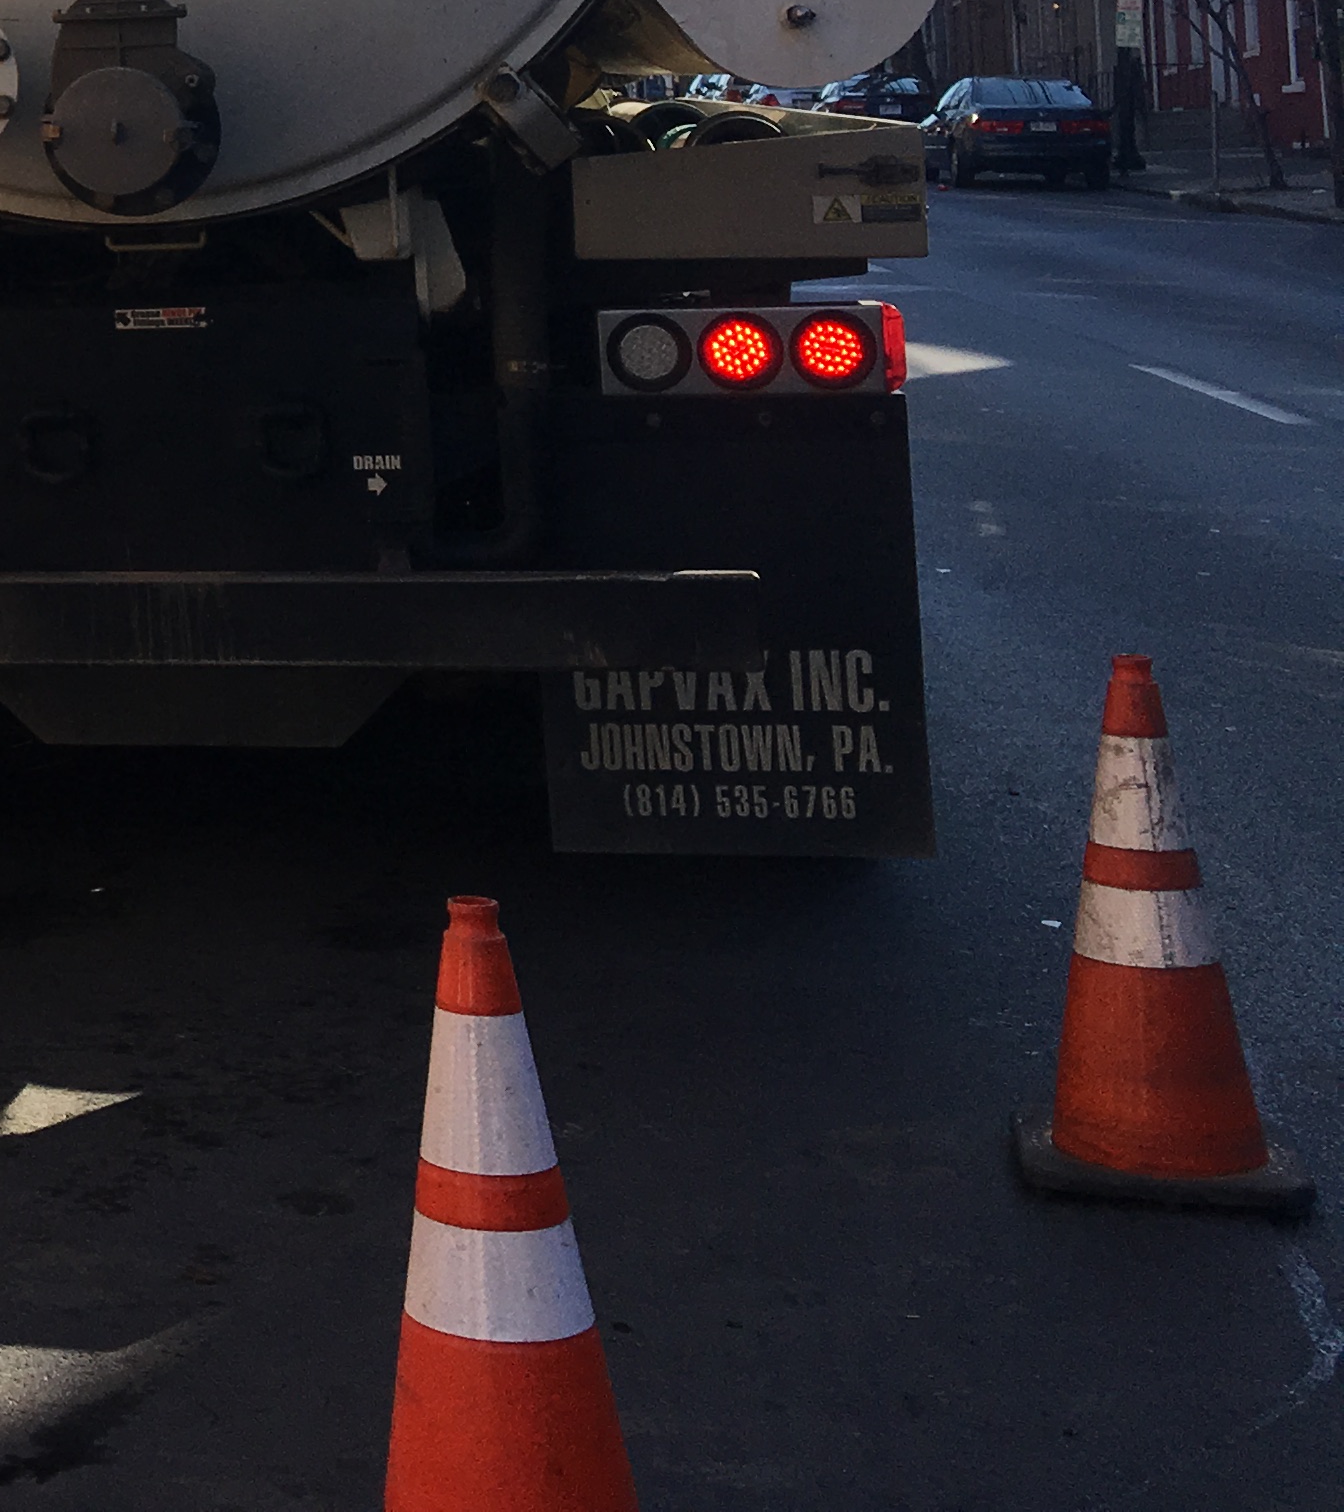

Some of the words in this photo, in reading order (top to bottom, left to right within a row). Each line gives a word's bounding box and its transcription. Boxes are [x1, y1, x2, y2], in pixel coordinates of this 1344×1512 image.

[352, 454, 402, 472] DRAIN
[573, 658, 772, 711] GAPVAX
[789, 648, 890, 713] INC.
[580, 722, 815, 772] JOHNSTOWN,
[831, 724, 894, 774] PA.
[622, 784, 701, 818] (814)
[715, 785, 857, 820] 535-6766
